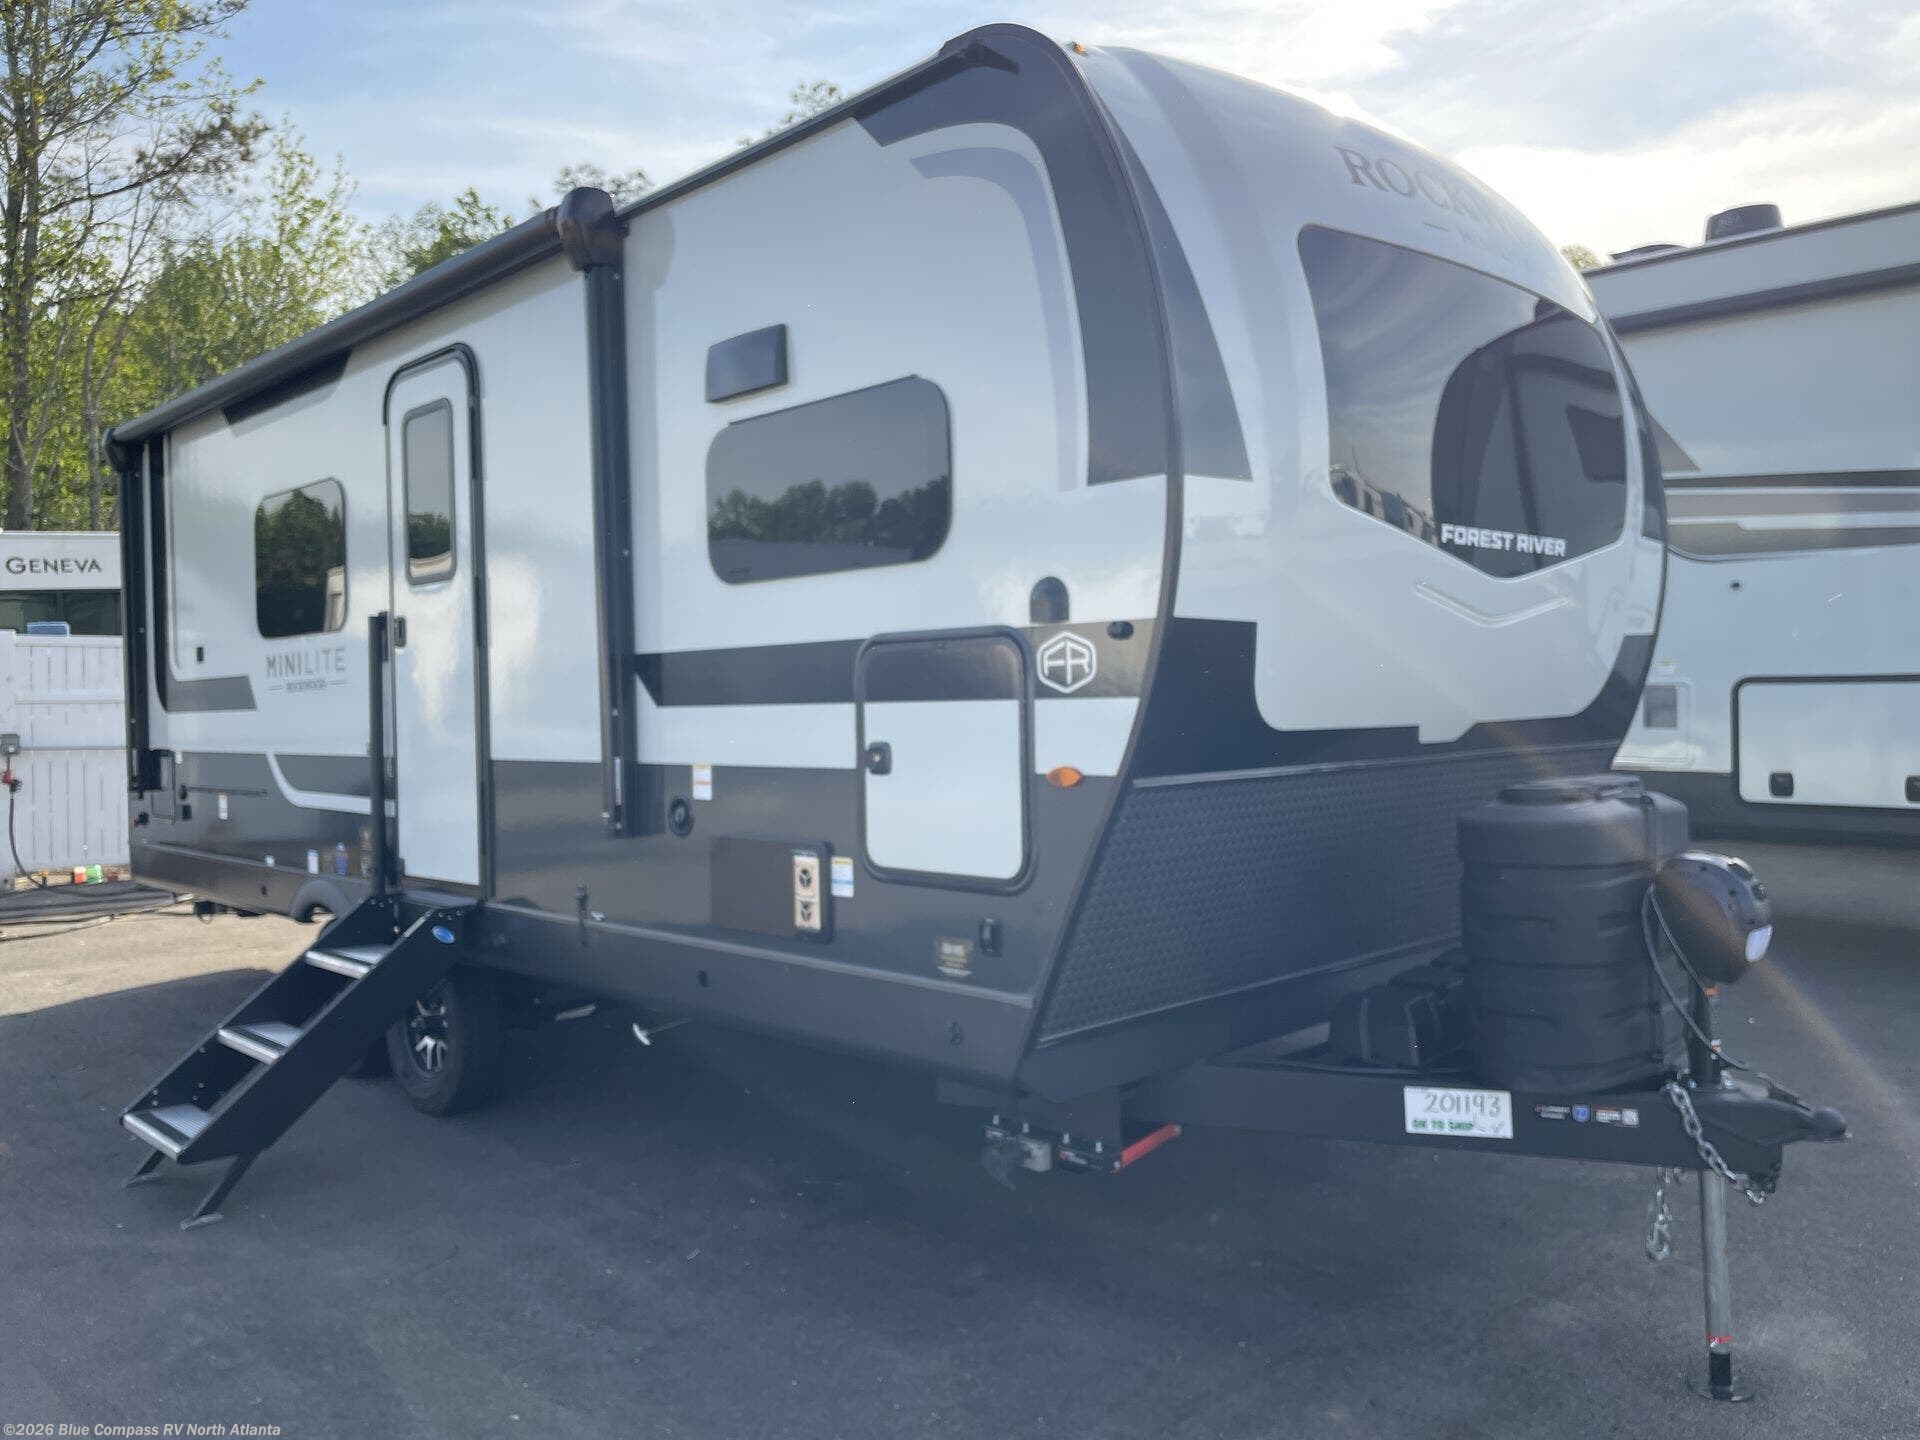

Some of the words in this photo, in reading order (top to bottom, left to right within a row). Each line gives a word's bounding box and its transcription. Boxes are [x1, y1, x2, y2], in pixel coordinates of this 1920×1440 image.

[1440, 523, 1514, 551] FOREST
[1515, 533, 1567, 557] RIVER
[5, 557, 102, 575] GENEVA
[1423, 1092, 1501, 1118] 201193
